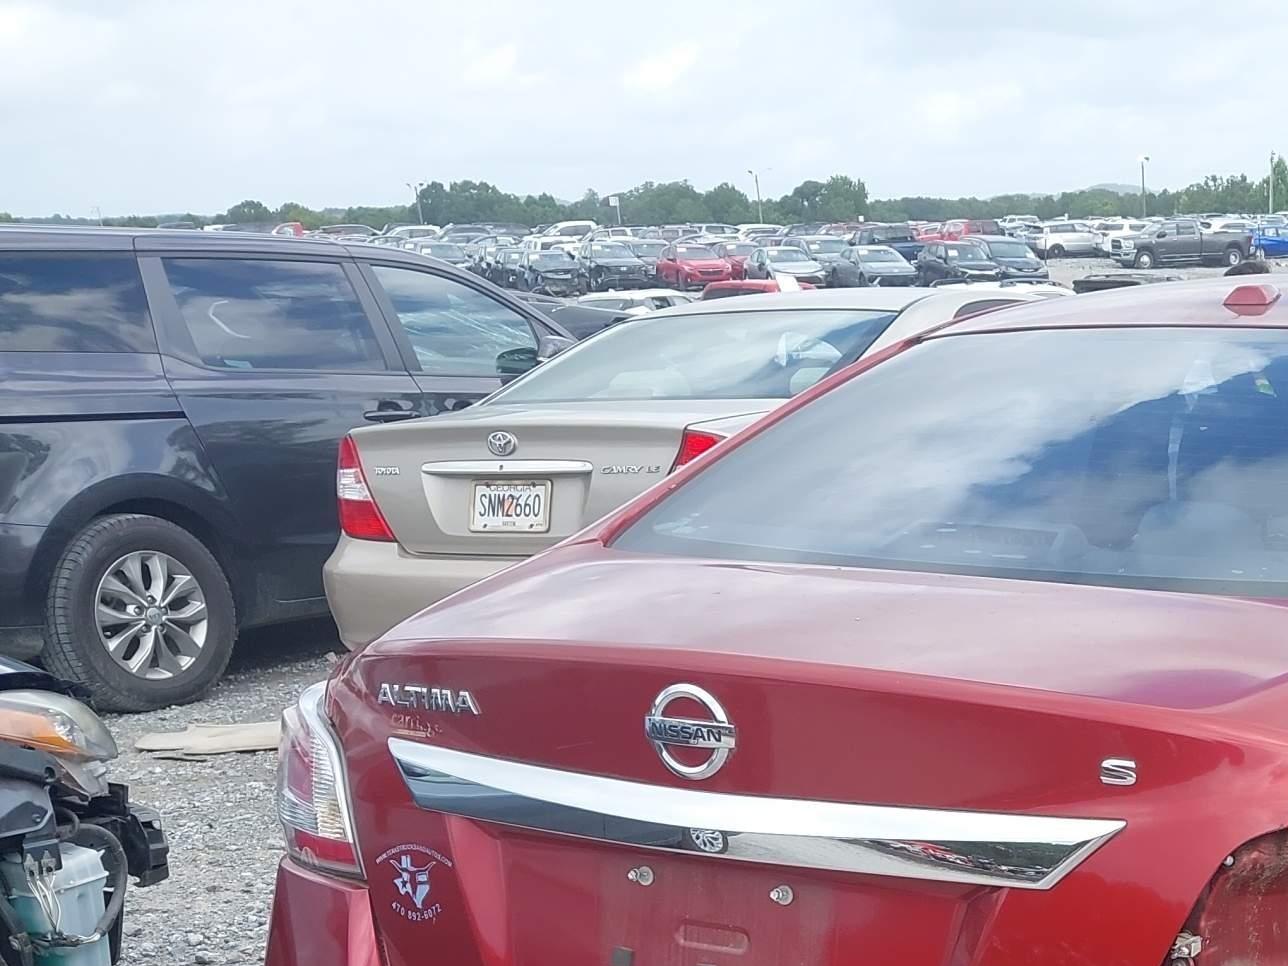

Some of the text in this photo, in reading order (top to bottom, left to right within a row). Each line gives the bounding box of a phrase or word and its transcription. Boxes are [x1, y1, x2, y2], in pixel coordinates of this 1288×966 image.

[600, 465, 662, 475] CAMRY LE
[479, 493, 541, 518] SNM2660
[378, 683, 482, 715] ALTIMA
[651, 721, 722, 743] NISSAN
[1100, 758, 1137, 786] S
[391, 901, 443, 921] 470 892-6072
